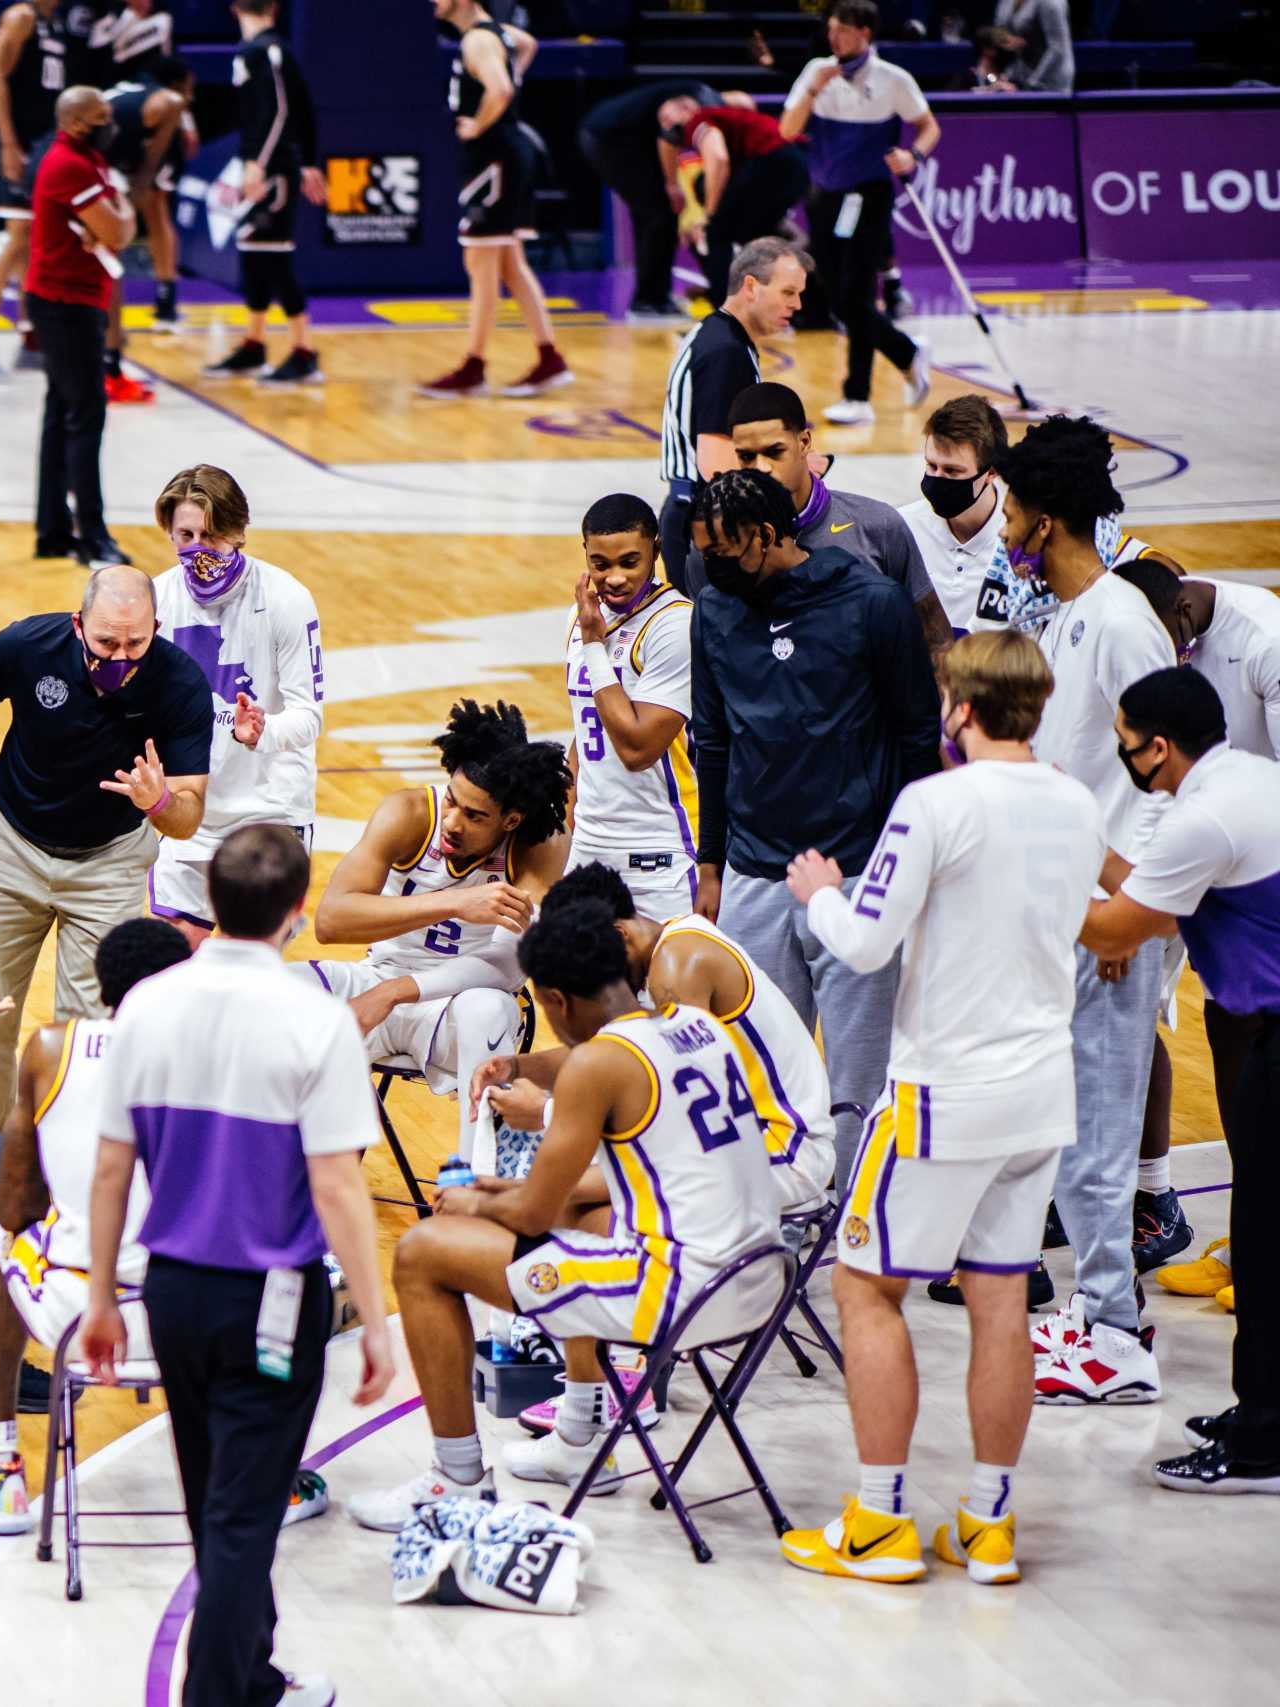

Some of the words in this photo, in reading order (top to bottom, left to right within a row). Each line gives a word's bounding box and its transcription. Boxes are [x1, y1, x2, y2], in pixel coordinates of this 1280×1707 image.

[1092, 171, 1161, 216] OF
[1181, 169, 1280, 214] LOU
[307, 619, 324, 702] LSU
[581, 707, 606, 761] 3
[854, 821, 911, 920] LSU
[424, 919, 462, 955] 2
[85, 1033, 105, 1059] LE
[672, 1051, 757, 1154] 24
